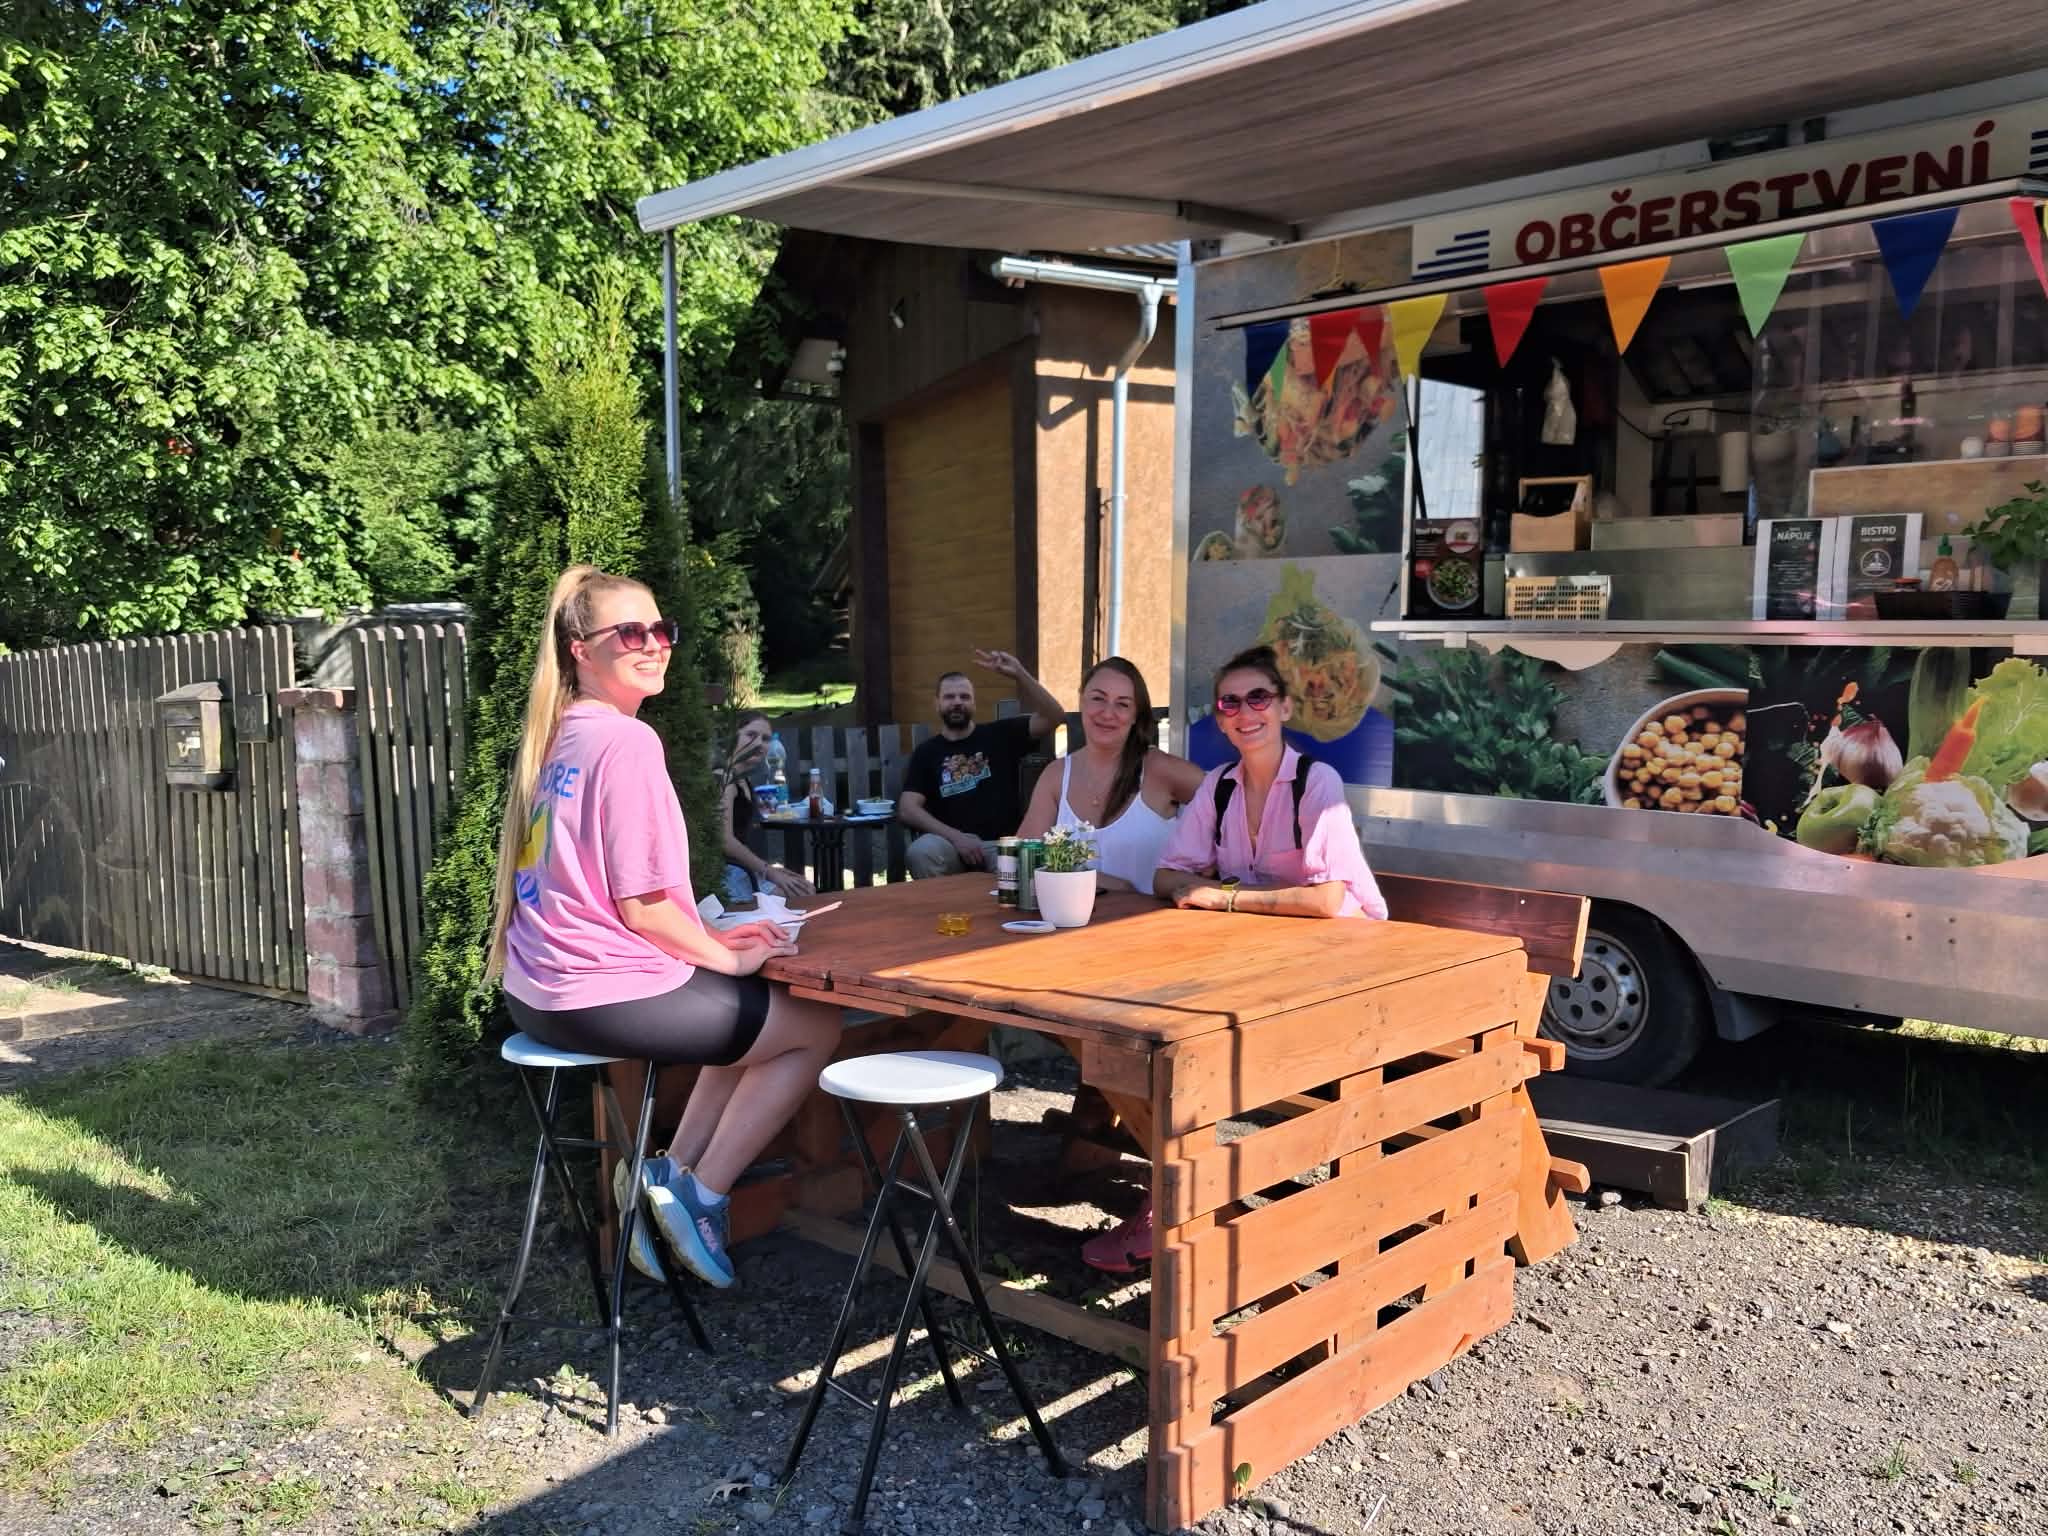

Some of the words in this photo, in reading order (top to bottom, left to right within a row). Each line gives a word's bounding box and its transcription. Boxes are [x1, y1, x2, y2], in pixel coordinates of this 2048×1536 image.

[1515, 120, 1996, 266] OBČERSTVENÍ
[1777, 530, 1813, 542] NÁPOJE
[1861, 526, 1897, 536] BISTRO
[540, 762, 580, 798] ORE
